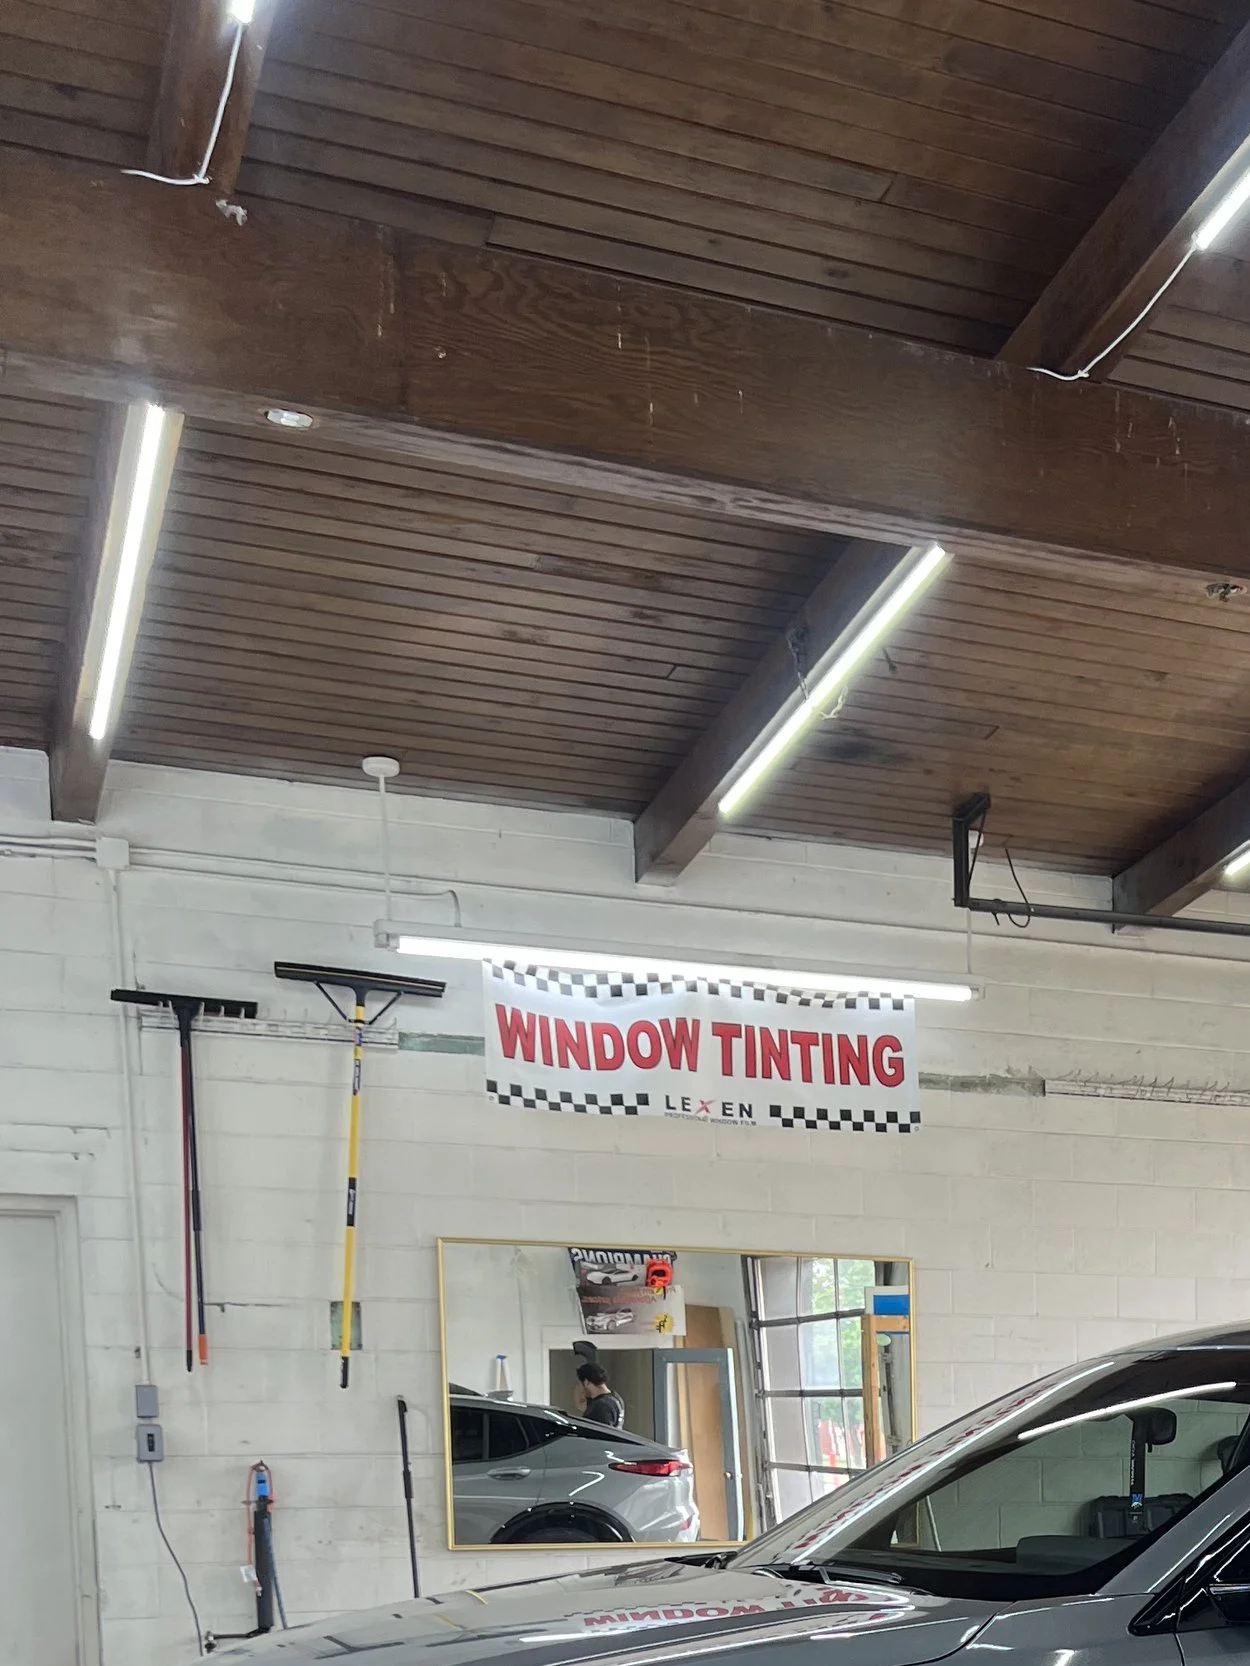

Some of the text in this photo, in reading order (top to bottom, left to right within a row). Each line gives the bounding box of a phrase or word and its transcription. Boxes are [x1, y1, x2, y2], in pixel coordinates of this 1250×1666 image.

[495, 1003, 905, 1087] WINDOW TINTING
[665, 1094, 753, 1118] LEXEN
